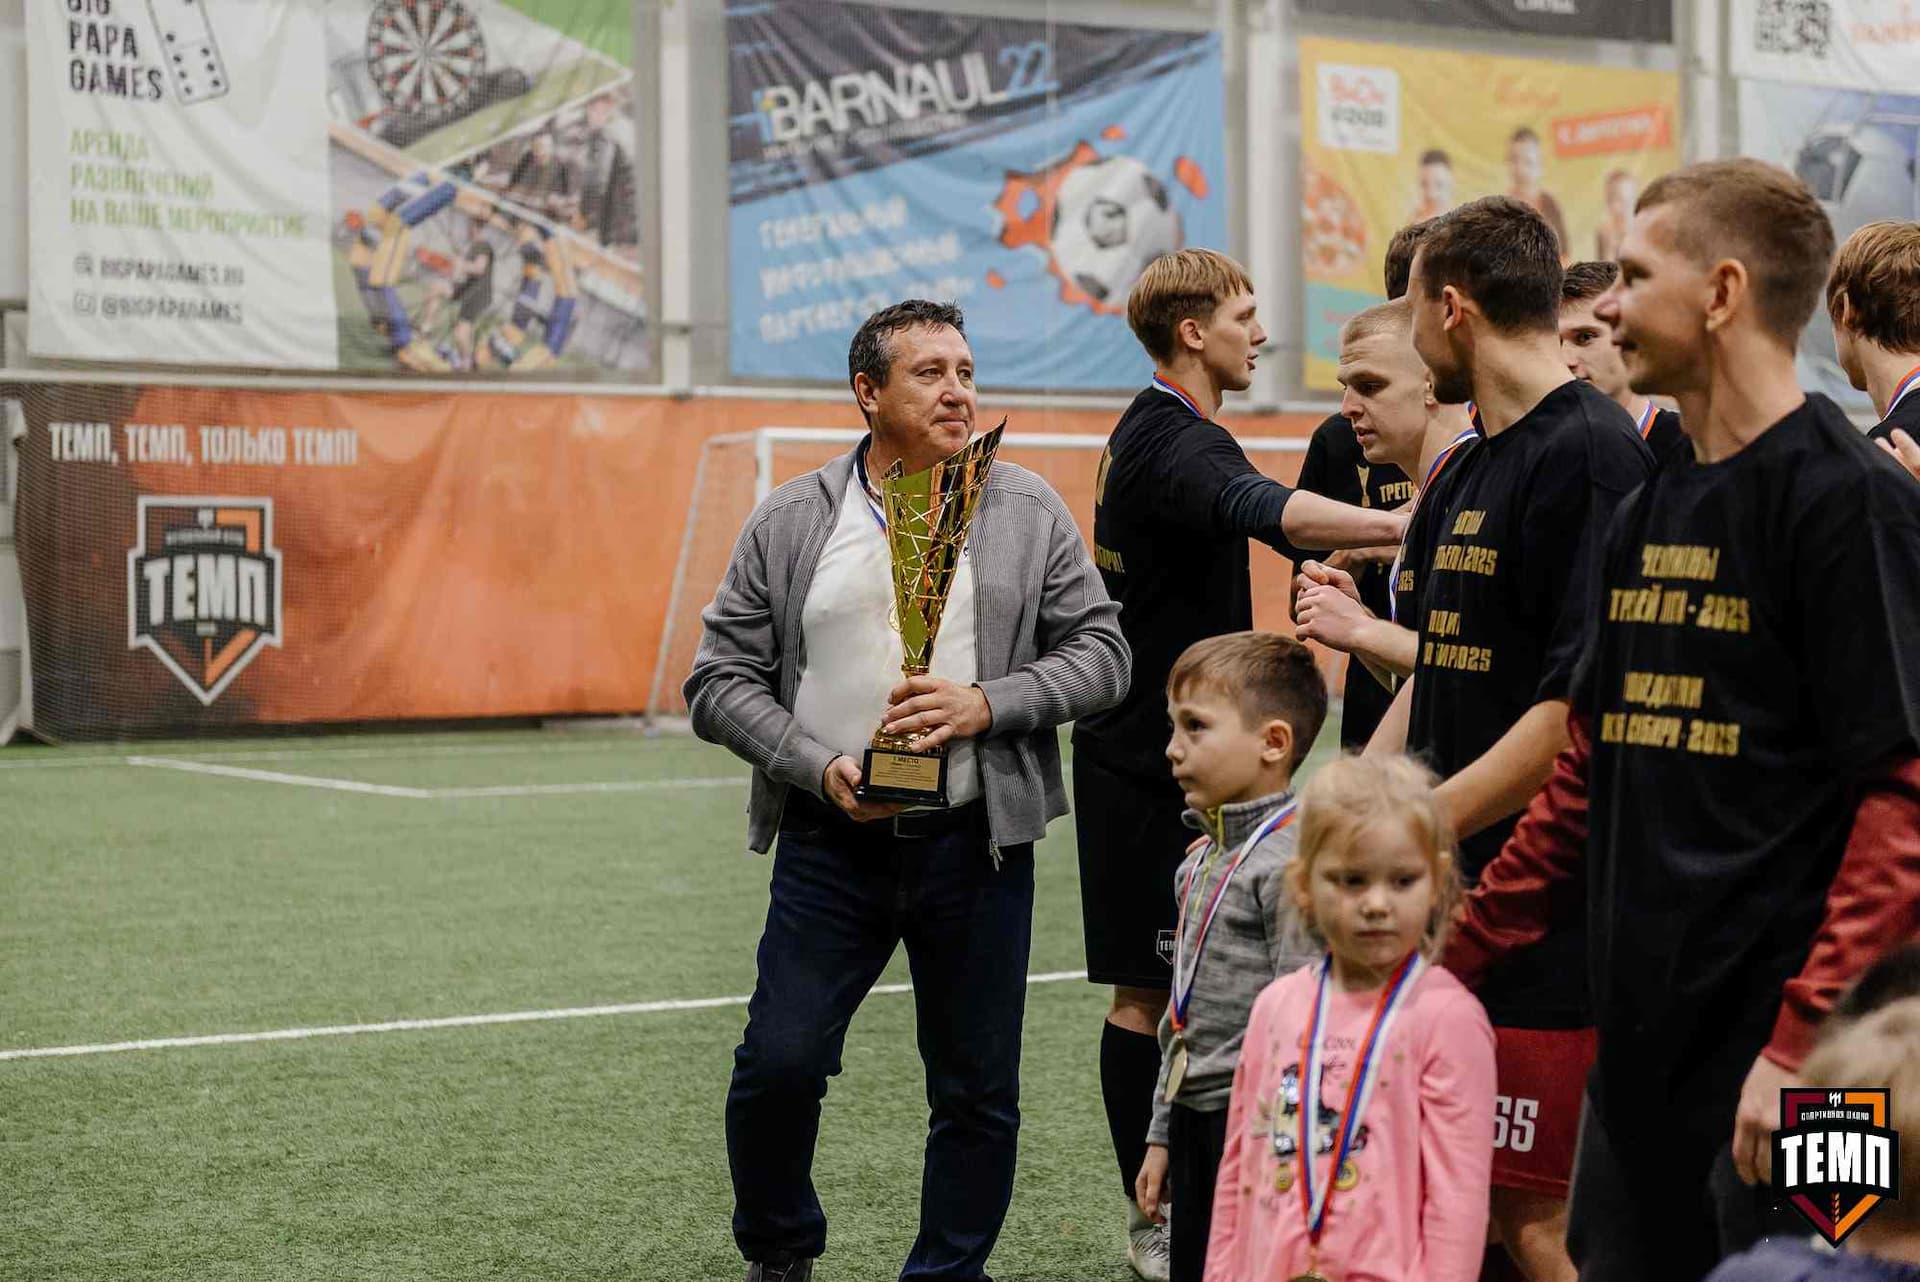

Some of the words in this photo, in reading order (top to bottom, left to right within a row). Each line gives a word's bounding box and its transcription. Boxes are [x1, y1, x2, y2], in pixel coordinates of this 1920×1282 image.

[70, 21, 137, 58] PAPA
[71, 60, 161, 99] GAMES
[48, 422, 118, 465] ТЕМП,
[124, 424, 193, 467] ТЕМП,
[199, 425, 286, 464] ТОЛЬКО
[292, 428, 357, 465] ТЕМП!
[144, 554, 266, 626] ТЕМП
